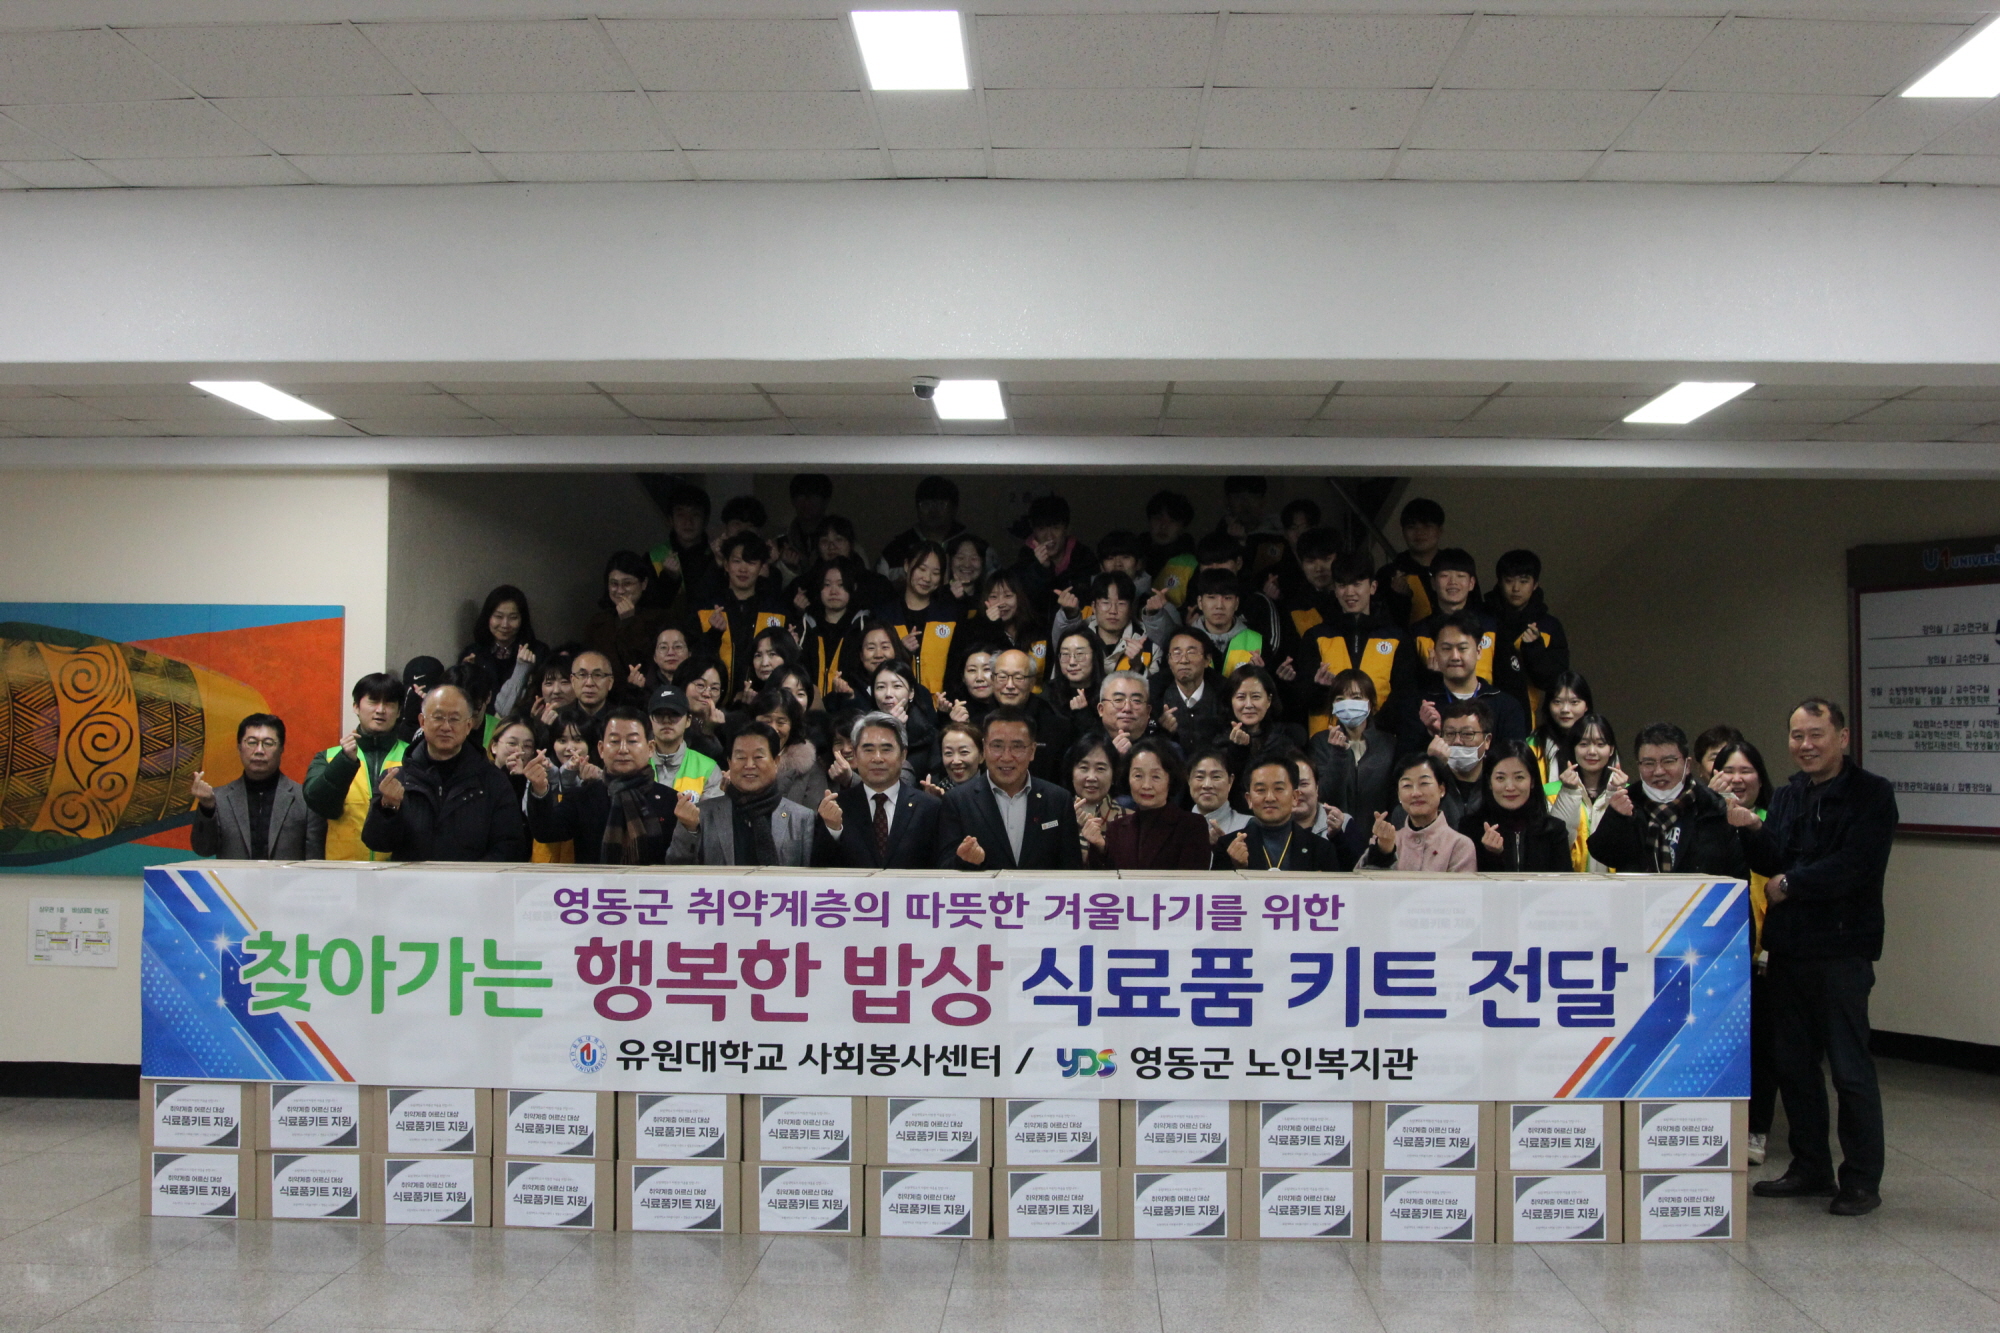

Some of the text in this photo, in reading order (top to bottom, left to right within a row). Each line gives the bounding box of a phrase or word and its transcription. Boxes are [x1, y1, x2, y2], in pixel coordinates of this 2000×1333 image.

[1922, 622, 1989, 635] 강의실 교수연구실
[1955, 653, 1990, 663] 교수연구실
[1956, 684, 1990, 694] 교수연구실
[554, 887, 1346, 932] 영동군 취약계층의 따뜻한 겨울나기를 위한
[242, 930, 1629, 1028] 찾아가는 행복한 밥상 식료품 키트 전달
[616, 1040, 789, 1075] 유원대학교
[799, 1042, 1002, 1079] 사회봉사센터
[1130, 1046, 1236, 1082] 영동군
[1245, 1047, 1420, 1082] 노인복지관
[170, 1105, 193, 1113] 취약계층
[212, 1106, 225, 1114] 대상
[161, 1115, 234, 1128] 식료품키트 지원
[278, 1115, 352, 1127] 식료품키트 지원
[524, 1112, 547, 1120] 취약계층
[567, 1114, 580, 1122] 대상
[653, 1116, 677, 1124] 취약계층
[678, 1116, 697, 1124] 어르신
[777, 1118, 801, 1126] 취약계층
[822, 1119, 835, 1127] 대상
[395, 1120, 468, 1132] 식료품키트 지원
[514, 1122, 589, 1136] 식료품키트 지원
[1069, 1121, 1082, 1129] 대상
[1179, 1122, 1198, 1130] 어르신
[1199, 1122, 1212, 1130] 대상
[1277, 1124, 1302, 1132] 취약계층
[1553, 1127, 1572, 1135] 어르신
[644, 1126, 719, 1138] 식료품키트 지원
[768, 1128, 844, 1141] 식료품키트 지원
[895, 1130, 972, 1142] 식료품키트 지원
[1014, 1131, 1092, 1143] 식료품키트 지원
[1144, 1132, 1221, 1144] 식료품키트 지원
[1268, 1134, 1345, 1147] 식료품키트 지원
[1393, 1136, 1470, 1149] 식료품키트 지원
[1518, 1137, 1595, 1149] 식료품키트 지원
[1647, 1135, 1723, 1147] 식료품키트 지원
[168, 1174, 190, 1182] 취약계층
[191, 1175, 209, 1183] 어르신
[159, 1184, 231, 1197] 식료품키트 지원
[401, 1181, 424, 1189] 취약계층
[279, 1185, 352, 1198] 식료품키트 지원
[393, 1191, 467, 1203] 식료품키트 지원
[674, 1188, 693, 1196] 어르신
[694, 1188, 707, 1196] 대상
[898, 1193, 922, 1201] 취약계층
[513, 1193, 587, 1207] 식료품키트 지원
[640, 1197, 716, 1210] 식료품키트 지원
[767, 1198, 843, 1211] 식료품키트 지원
[1399, 1197, 1458, 1206] 취약계층 어르신 대상
[888, 1203, 965, 1216] 식료품키트 지원
[1016, 1204, 1094, 1216] 식료품키트 지원
[1142, 1204, 1219, 1217] 식료품키트 지원
[1268, 1204, 1345, 1216] 식료품키트 지원
[1390, 1208, 1467, 1220] 식료품키트 지원
[1521, 1207, 1598, 1220] 식료품키트 지원
[1649, 1205, 1724, 1218] 식료품키트 지원
